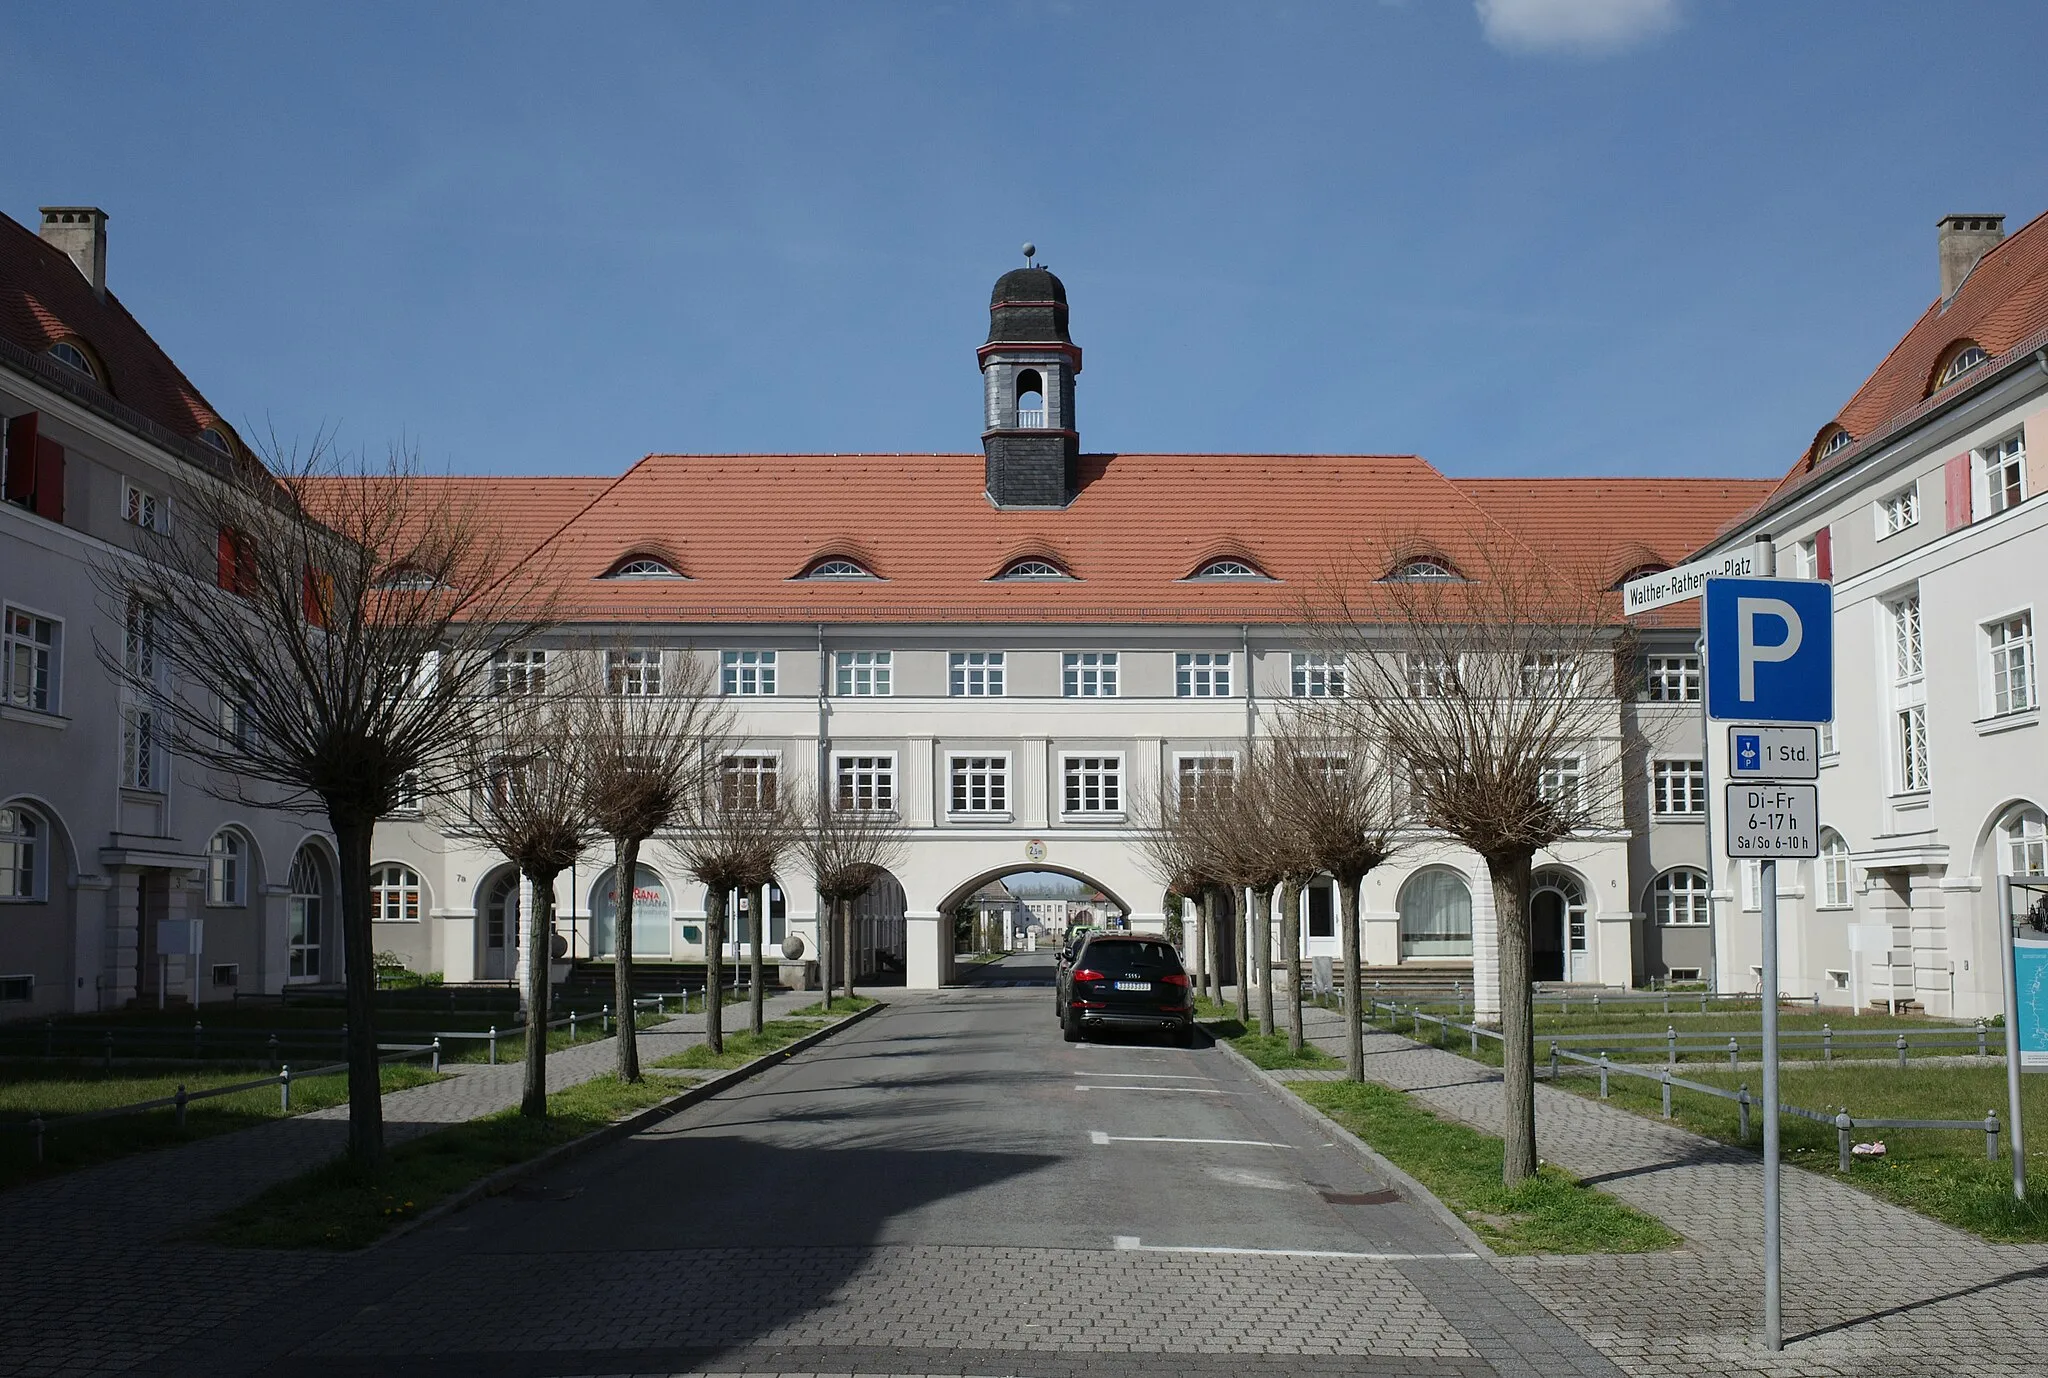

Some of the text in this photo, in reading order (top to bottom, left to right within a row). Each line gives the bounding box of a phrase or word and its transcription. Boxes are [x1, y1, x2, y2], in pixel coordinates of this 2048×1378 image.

[1738, 597, 1803, 702] P
[1766, 746, 1810, 762] 1 Std.
[1748, 792, 1795, 809] Di-Fr
[1748, 813, 1797, 830] 6-17 h
[1738, 836, 1808, 849] Sa/So 6-10 h
[456, 874, 467, 883] 7a
[1611, 879, 1617, 888] 6
